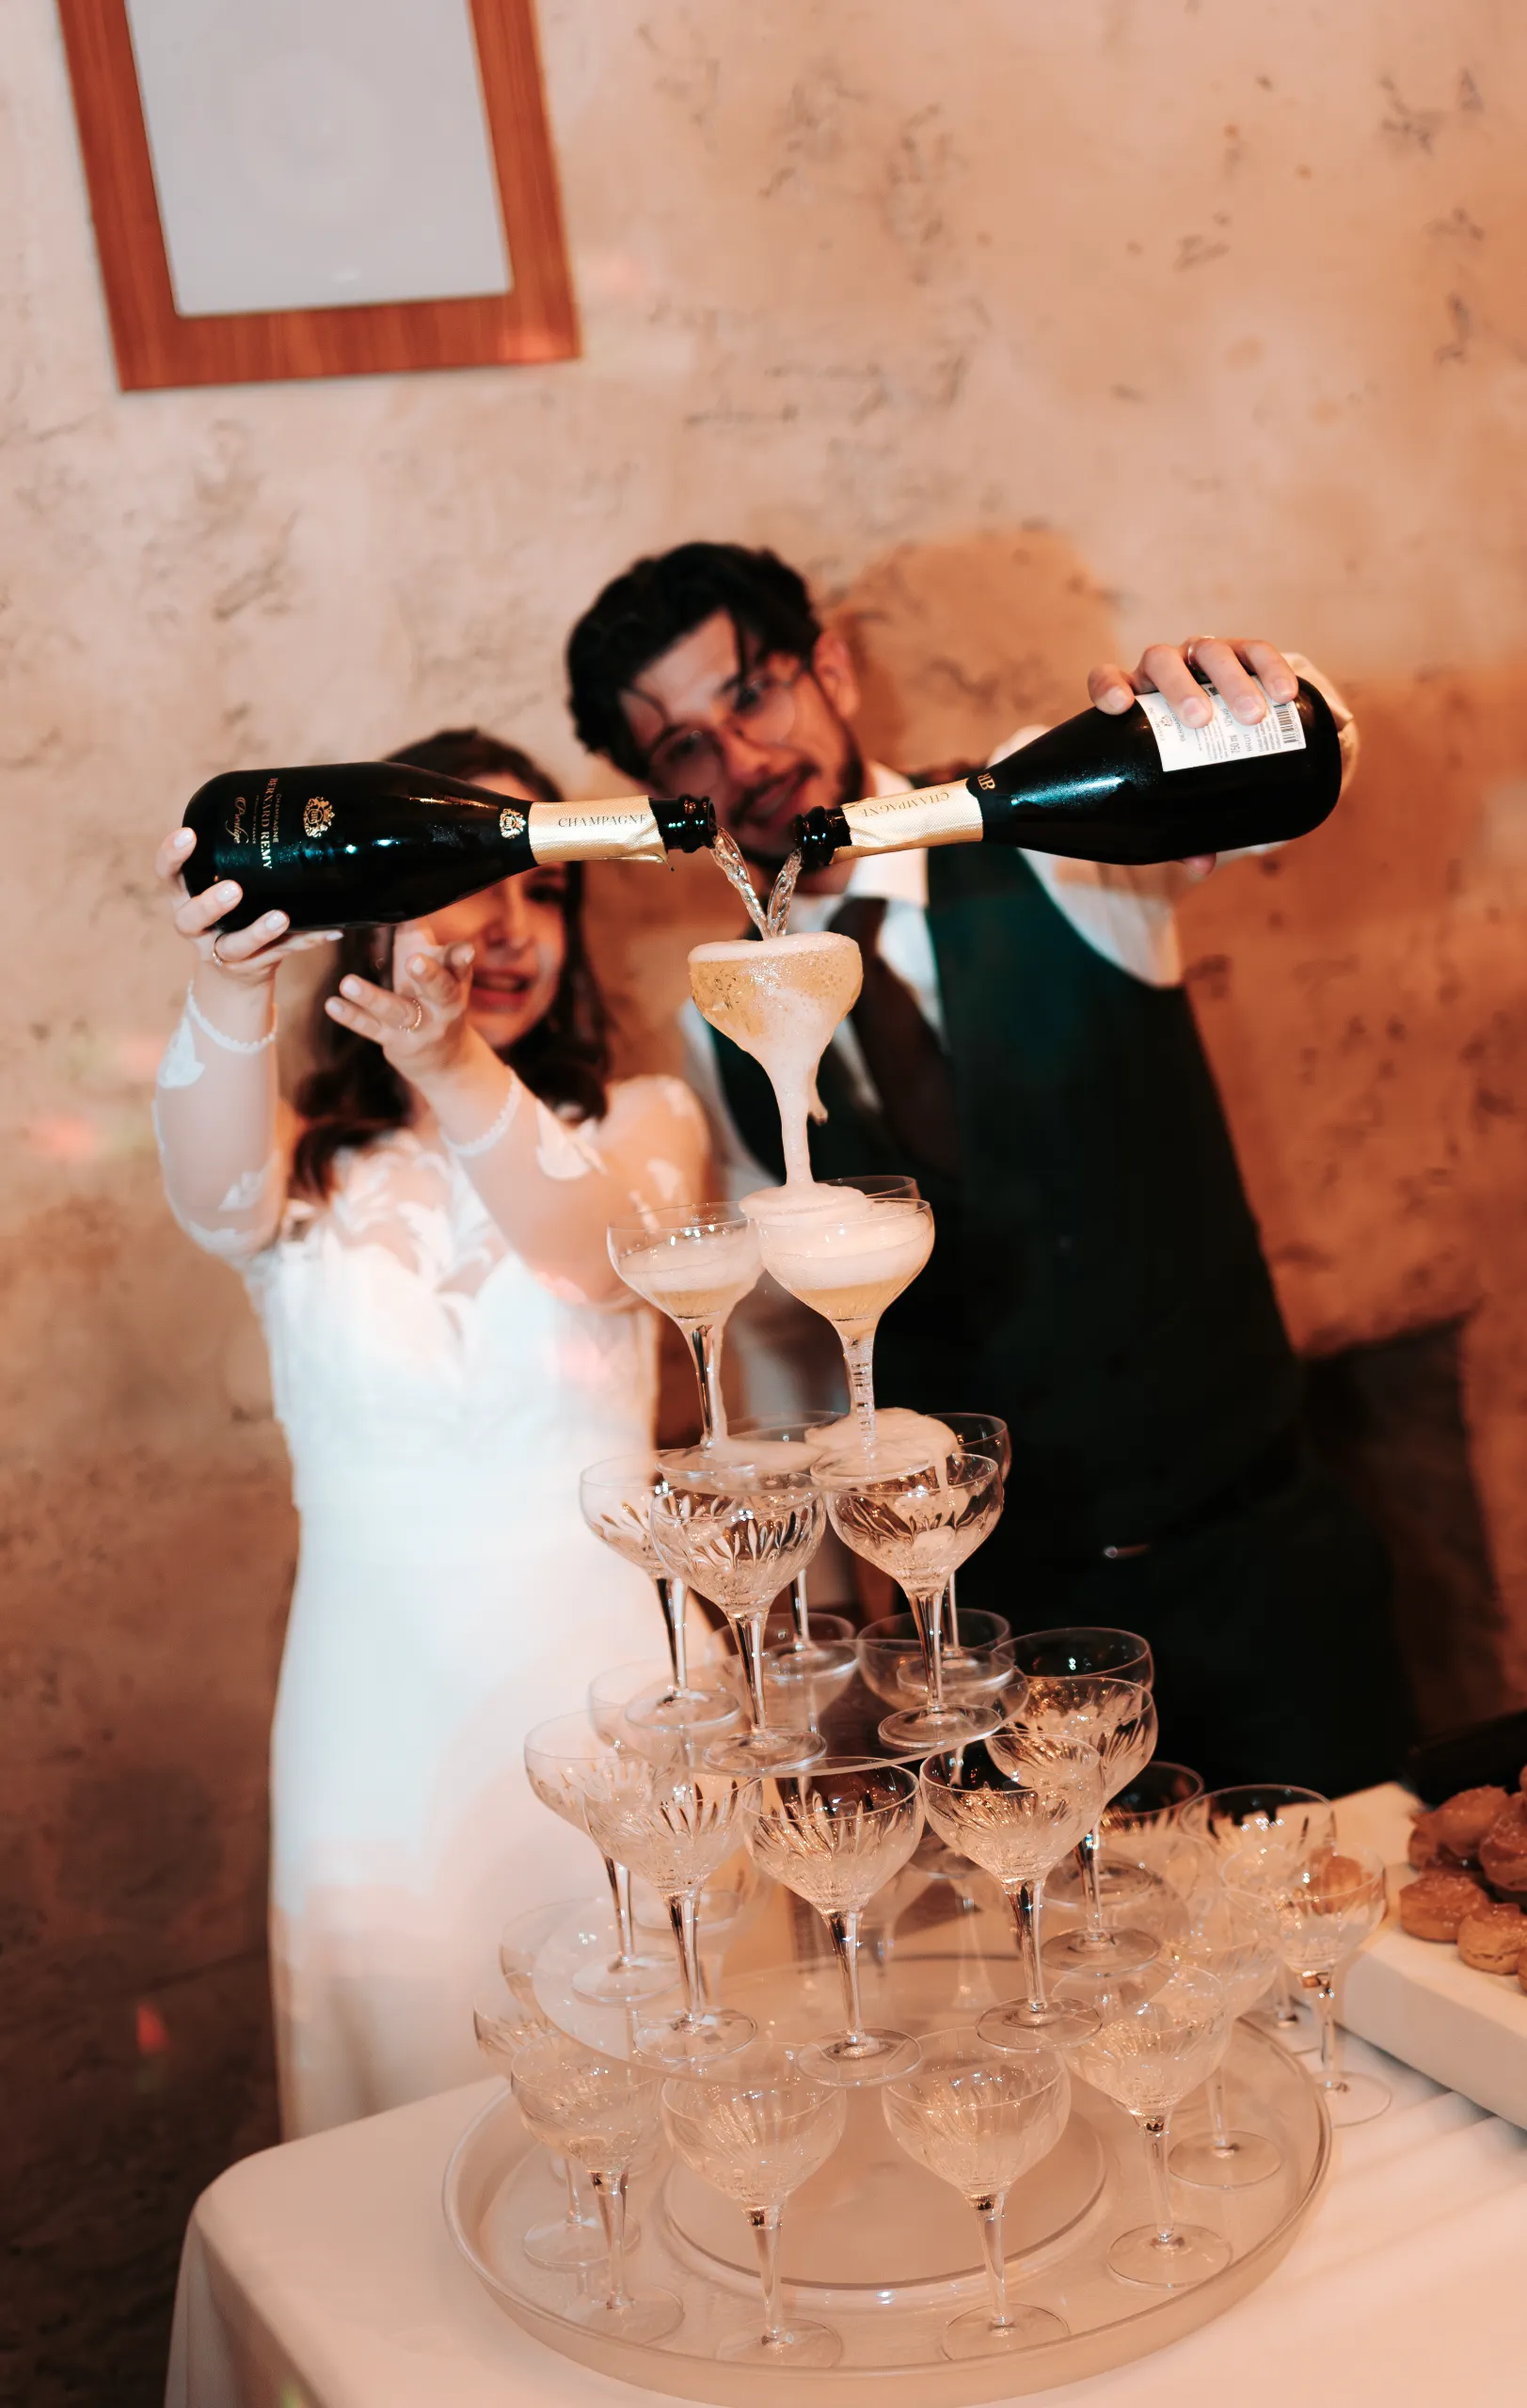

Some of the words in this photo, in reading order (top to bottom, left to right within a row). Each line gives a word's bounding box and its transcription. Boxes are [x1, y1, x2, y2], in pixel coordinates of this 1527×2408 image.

[1229, 742, 1240, 753] 750
[1243, 734, 1253, 752] BRUT
[262, 778, 278, 827] BERNARD
[859, 792, 950, 816] CHAMPAGNE
[225, 797, 249, 844] Prestige
[272, 793, 281, 843] CHAMPAGNE
[558, 814, 647, 828] CHAMPAGNE
[261, 832, 272, 869] REMY
